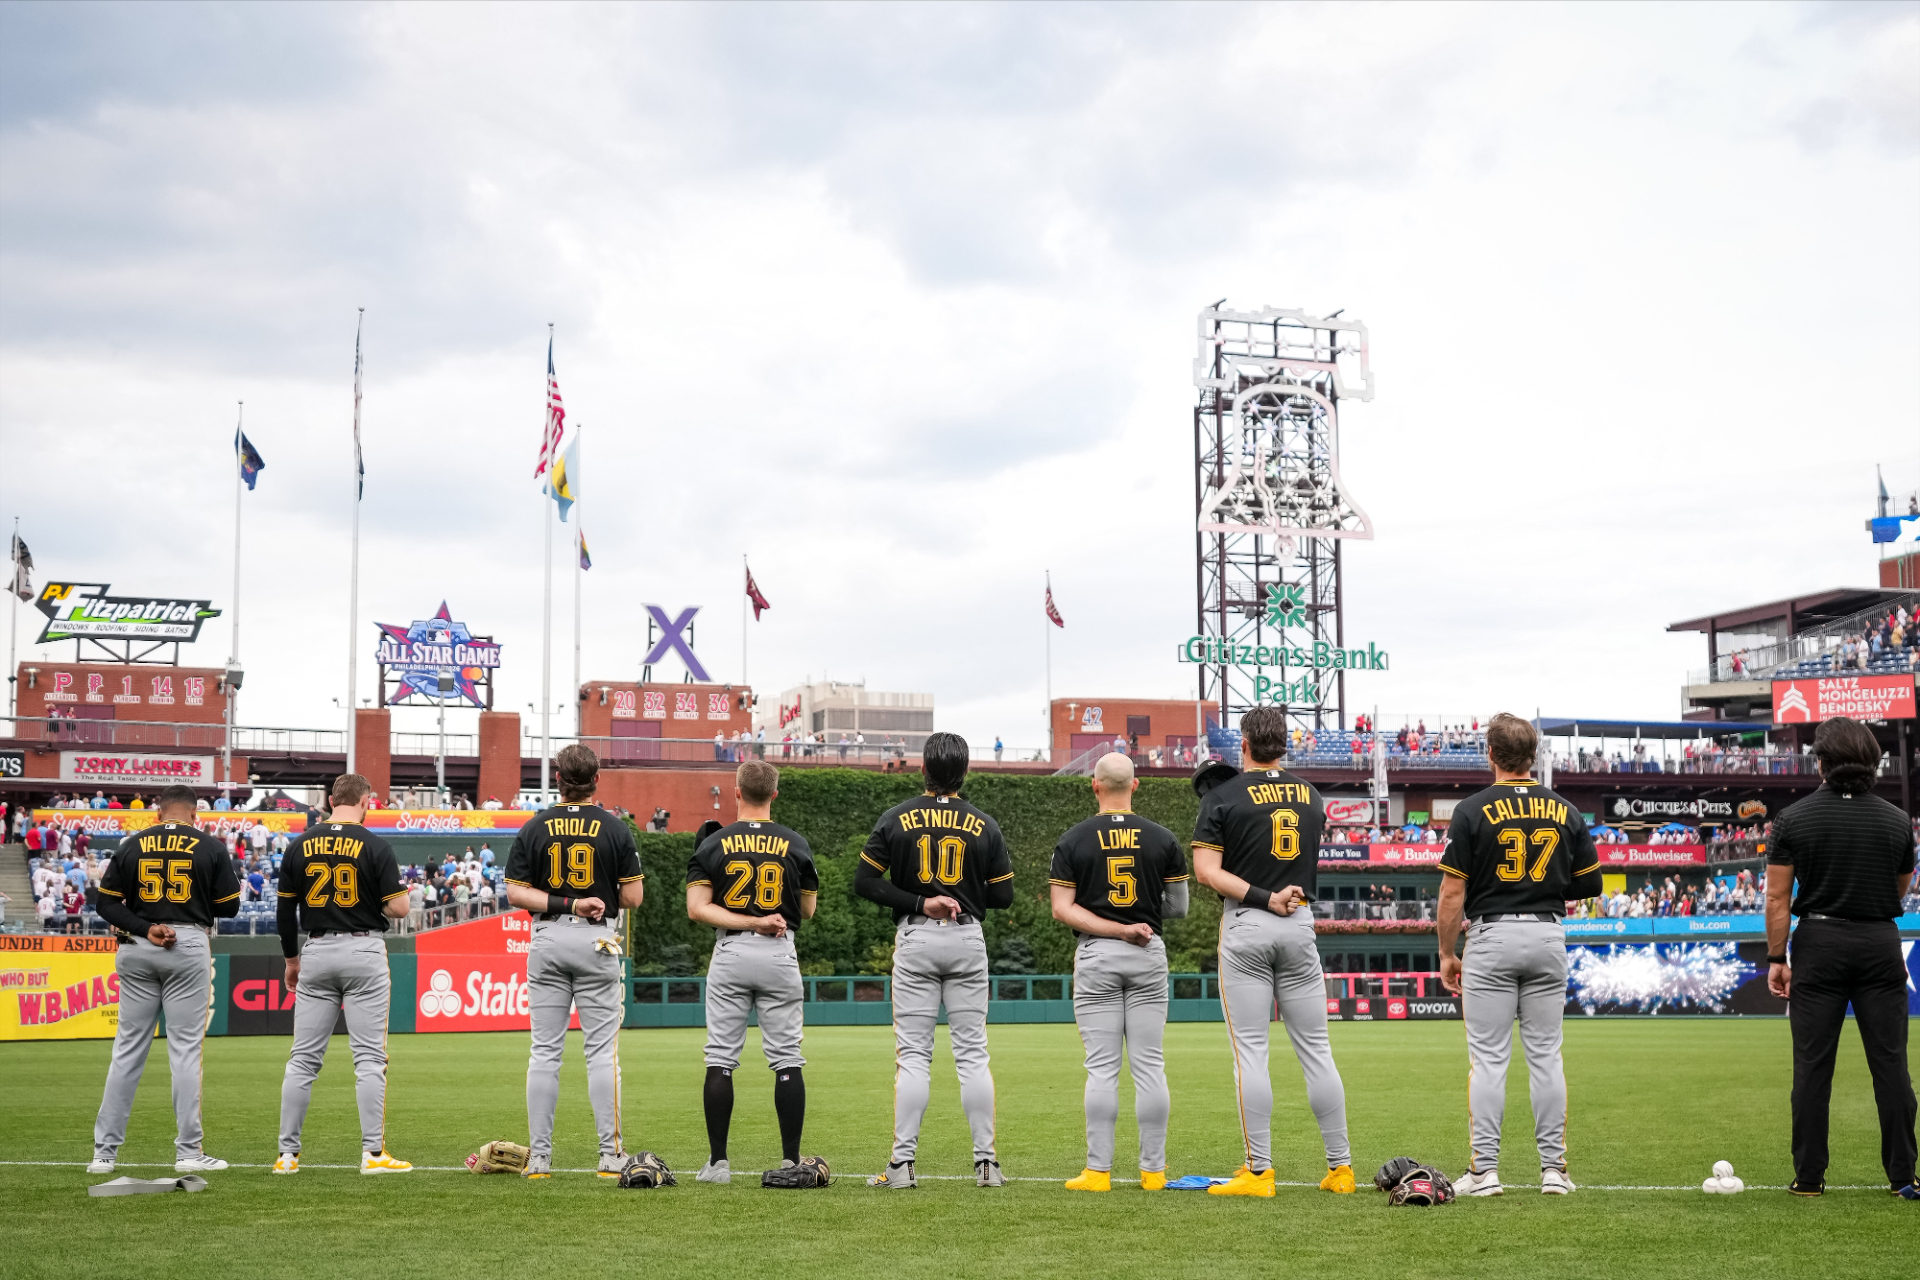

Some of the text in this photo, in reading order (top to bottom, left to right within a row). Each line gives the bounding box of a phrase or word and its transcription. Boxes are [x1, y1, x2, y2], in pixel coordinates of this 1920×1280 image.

[42, 584, 202, 621] PJ Fitzpatrick
[53, 623, 188, 634] WINDOWS ROOFING SIDING BATHS
[412, 642, 453, 665] STAR
[455, 643, 500, 666] GAME
[1185, 635, 1387, 671] Citizens Bank
[122, 675, 132, 695] 1
[152, 676, 173, 696] 14
[184, 677, 204, 697] 15
[1254, 674, 1321, 704] Park
[1818, 677, 1859, 690] SALTZ
[614, 691, 635, 709] 20
[644, 691, 666, 710] 32
[675, 692, 697, 711] 34
[709, 693, 729, 712] 36
[1818, 687, 1910, 701] MONGELUZZI
[1081, 706, 1103, 725] 42
[1820, 701, 1891, 714] BENDESKY
[74, 757, 201, 771] TONY LUKE'S
[1247, 783, 1310, 805] GRIFFIN
[1482, 797, 1568, 825] CALLIHAN
[1630, 799, 1689, 816] CHICKIE'S
[1697, 799, 1732, 818] PETE'S
[48, 812, 119, 831] Surfside
[396, 811, 460, 832] Surfside
[544, 817, 601, 838] TRIOLO
[899, 808, 986, 837] REYNOLDS
[1097, 828, 1142, 850] LOWE
[1269, 808, 1301, 860] 6
[139, 835, 200, 854] VALDEZ
[303, 836, 364, 859] O'HEARN
[721, 834, 790, 858] MANGUM
[1330, 848, 1345, 858] For
[1346, 849, 1361, 858] You
[1496, 827, 1560, 882] 37
[916, 834, 967, 886] 10
[1629, 849, 1693, 861] Budweiser
[548, 842, 595, 889] 19
[138, 858, 193, 903] 55
[305, 862, 360, 908] 29
[723, 860, 784, 910] 28
[1106, 855, 1138, 907] 5
[502, 916, 529, 931] Like a
[1564, 921, 1613, 933] ependence
[507, 938, 530, 953] State
[0, 972, 48, 987] WHO BUT
[464, 970, 530, 1016] State
[1410, 1003, 1457, 1014] TOYOTA
